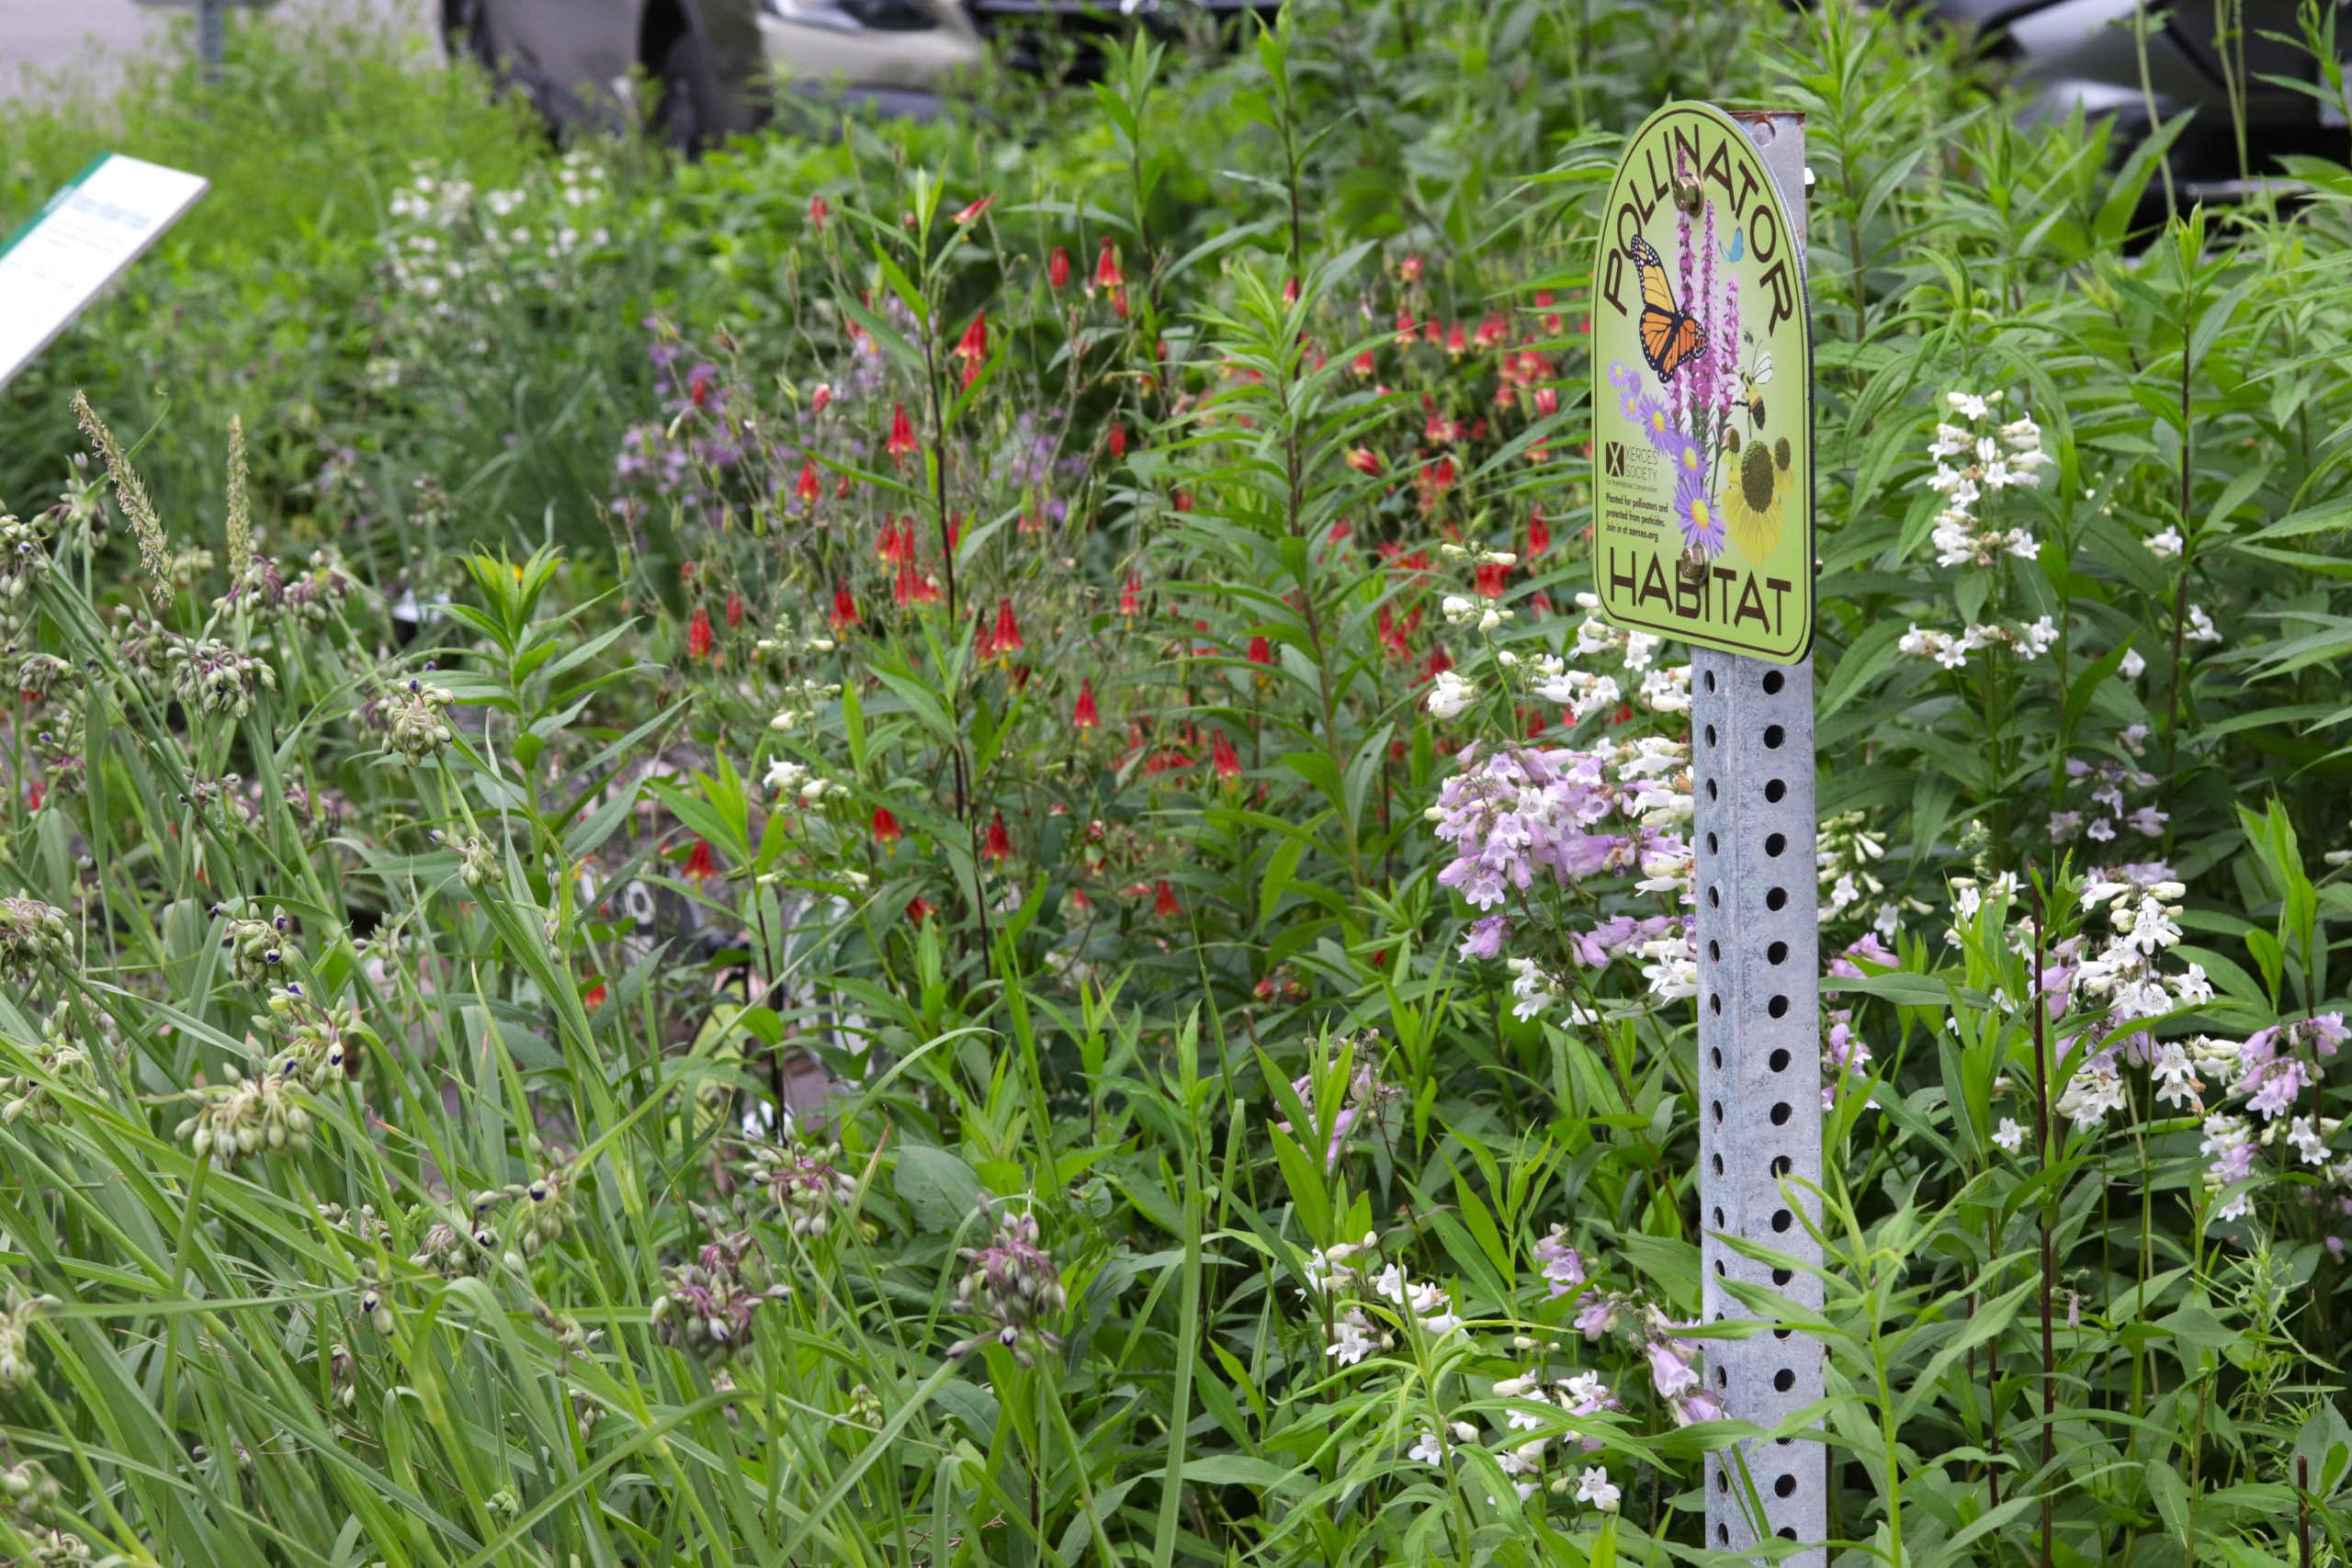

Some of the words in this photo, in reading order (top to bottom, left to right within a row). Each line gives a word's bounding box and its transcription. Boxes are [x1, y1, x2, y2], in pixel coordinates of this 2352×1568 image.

[1603, 124, 1792, 338] POLLINATOR
[1625, 447, 1657, 465] XERCES
[1626, 465, 1657, 481] SOCIETY
[1606, 492, 1623, 504] Planted
[1633, 497, 1657, 510] pollinators
[1659, 502, 1668, 512] and
[1606, 509, 1627, 520] protected
[1629, 512, 1640, 521] from
[1642, 515, 1665, 527] pesticides.
[1606, 522, 1615, 532] Join
[1617, 524, 1622, 533] in
[1629, 529, 1658, 542] xerces.org
[1610, 547, 1792, 636] HABITAT
